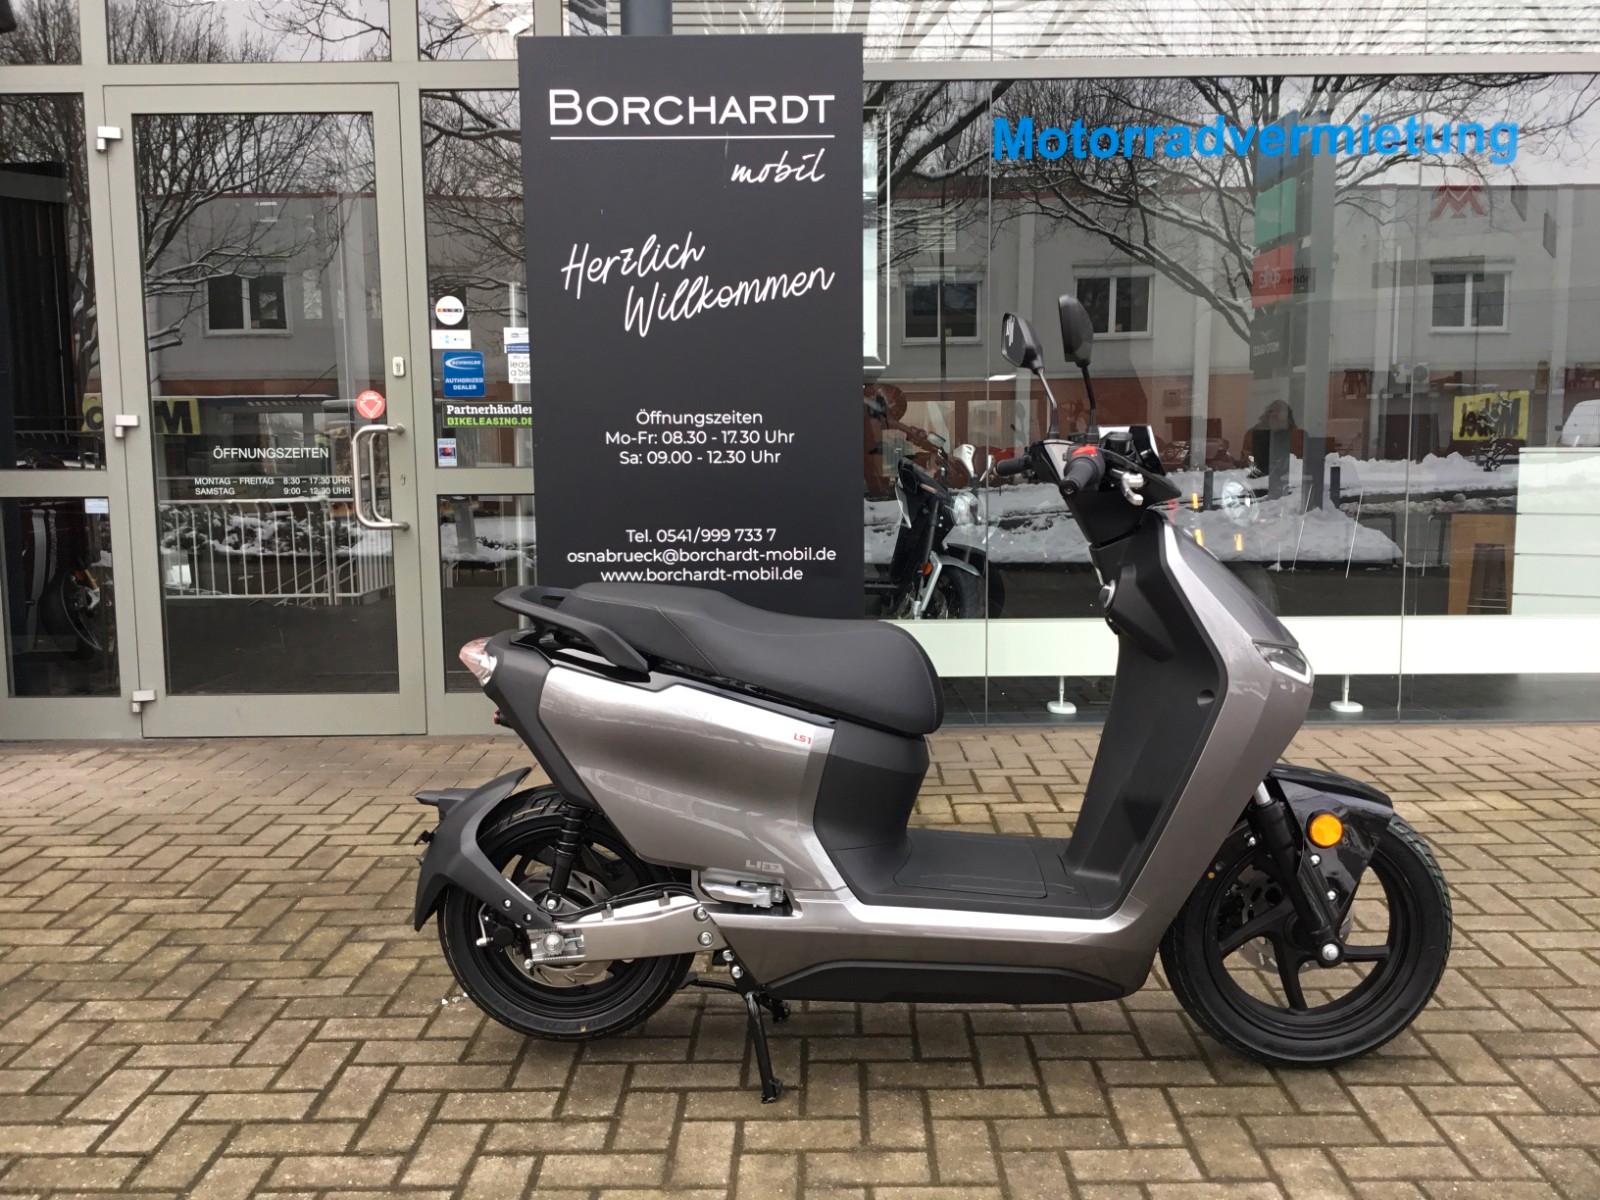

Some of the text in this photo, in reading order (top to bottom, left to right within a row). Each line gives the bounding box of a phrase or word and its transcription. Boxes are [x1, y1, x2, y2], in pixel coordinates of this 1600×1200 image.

[548, 88, 836, 127] BORCHARDT
[993, 114, 1519, 164] Motorradvermietung
[731, 147, 826, 183] mobil
[560, 231, 706, 300] Herzlich
[620, 266, 836, 338] Willkommen
[635, 409, 763, 428] Öffnungszeiten
[605, 431, 658, 445] Mo-Fr:
[662, 431, 708, 445] 08.30
[720, 430, 761, 445] 17.30
[765, 430, 796, 444] Uhr
[213, 446, 329, 460] ÖFFNUNGSZEITEN
[619, 451, 643, 465] Sa:
[647, 451, 693, 465] 09.00
[706, 450, 747, 465] 12.30
[751, 449, 782, 464] Uhr
[283, 477, 300, 485] 8:30
[332, 477, 351, 485] UHR
[195, 488, 235, 496] SAMSTAG
[332, 487, 351, 495] UHR
[625, 527, 777, 544] Tel. 0541/999 733 7
[566, 546, 837, 566] osnabrueck@borchardt-mobil.de
[600, 566, 804, 582] www.borchardt-mobil.de
[793, 732, 811, 745] LS1
